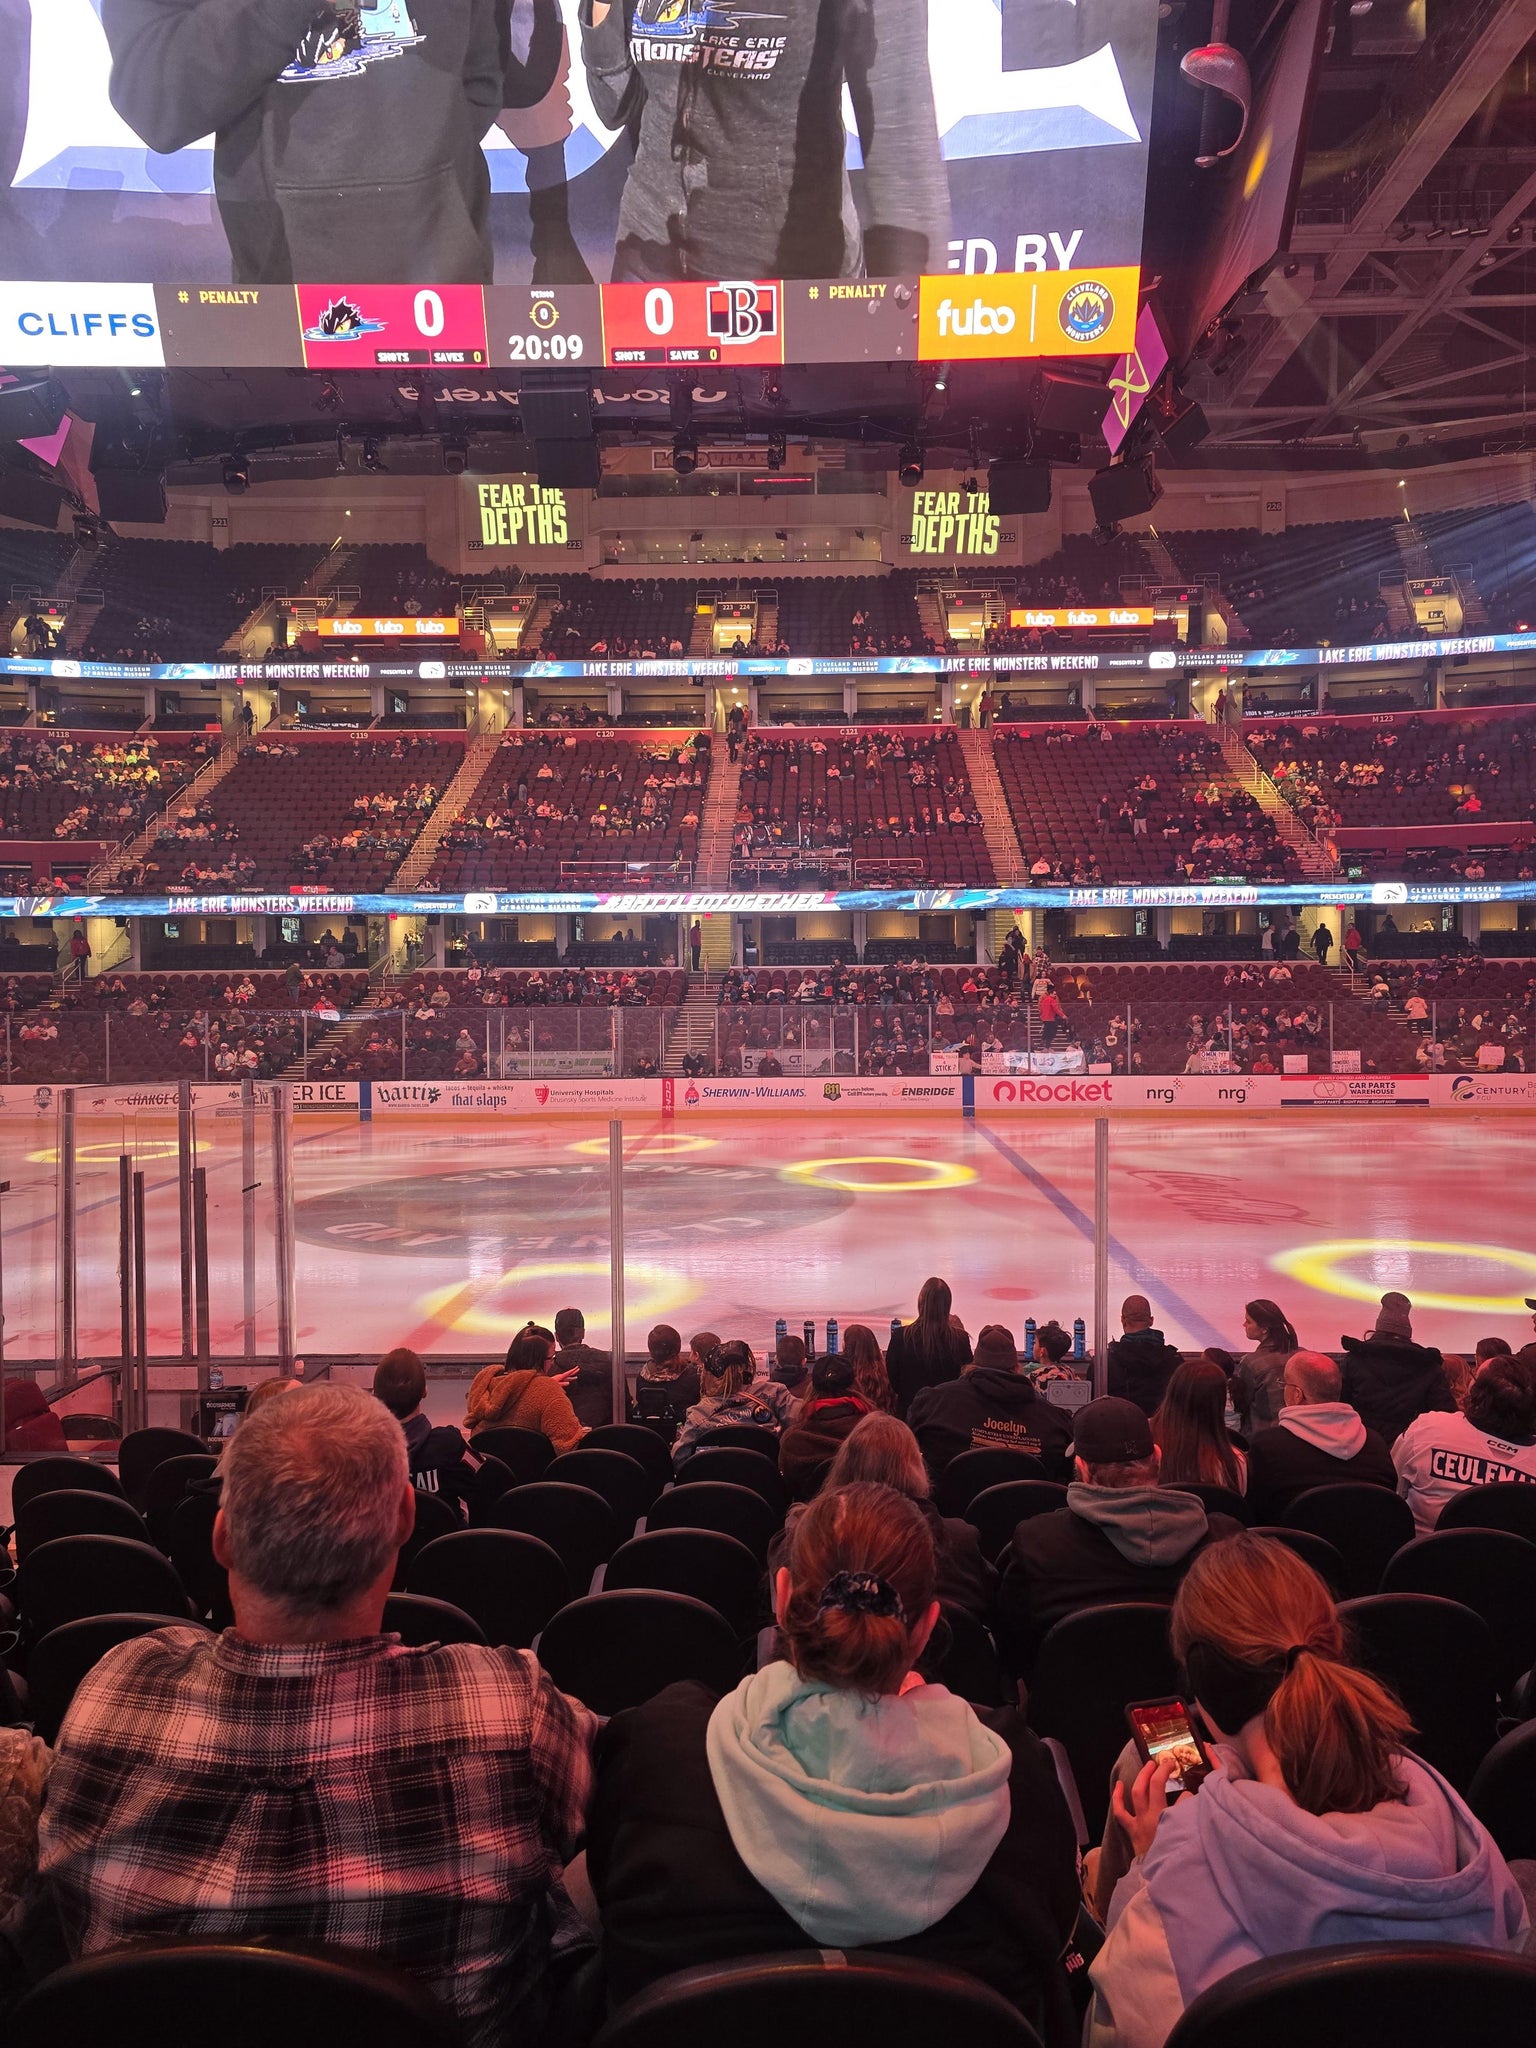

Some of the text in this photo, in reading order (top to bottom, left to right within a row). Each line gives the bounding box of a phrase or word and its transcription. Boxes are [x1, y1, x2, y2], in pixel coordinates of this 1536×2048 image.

[700, 33, 787, 48] LAKE ERIE
[1014, 229, 1084, 273] BY
[199, 291, 259, 304] PENALTY
[829, 284, 887, 300] PENALTY
[1066, 282, 1109, 302] CLEVELAND
[413, 289, 445, 337] 0
[644, 287, 674, 335] 0
[936, 298, 1016, 336] fubo
[17, 312, 155, 337] CLIFFS
[1065, 323, 1105, 341] MONSTERS
[508, 334, 584, 360] 20:09
[670, 349, 718, 361] SAVES 0
[377, 352, 409, 362] SHOTS
[433, 351, 482, 363] SAVES 0
[614, 351, 645, 361] SHOTS
[477, 483, 566, 507] FEAR THE
[913, 491, 961, 515] FEAR
[212, 518, 228, 527] 221
[480, 504, 568, 545] DEPTHS
[910, 514, 1000, 555] DEPTHS
[468, 541, 483, 549] 222
[567, 540, 582, 549] 223
[1025, 610, 1139, 626] fubo fubo fubo
[332, 620, 445, 634] fubo fubo fubo
[1318, 637, 1495, 664] LAKE ERIE MONSTERS WEEKEND
[212, 664, 370, 679] LAKE ERIE MONSTERS WEEKEND
[582, 661, 739, 676] LAKE ERIE MONSTERS WEEKEND
[940, 655, 1099, 672] LAKE ERIE MONSTERS WEEKEND
[169, 896, 354, 912] LAKE ERIE MONSTERS WEEKEND
[1069, 887, 1258, 906] LAKE ERIE MONSTERS WEEKEND
[320, 1084, 346, 1100] ICE
[493, 1084, 514, 1092] whiskey
[550, 1089, 582, 1097] University
[584, 1089, 614, 1097] Hospitals
[823, 1083, 840, 1095] 811
[901, 1087, 955, 1096] ENBRIDGE
[1019, 1079, 1113, 1102] Rocket
[1146, 1087, 1175, 1103] nrg
[1218, 1087, 1247, 1103] nrg
[1476, 1087, 1527, 1095] CENTURY
[452, 1093, 507, 1108] that slaps
[983, 1417, 1027, 1436] Jocelyn
[1486, 1439, 1519, 1454] CCM
